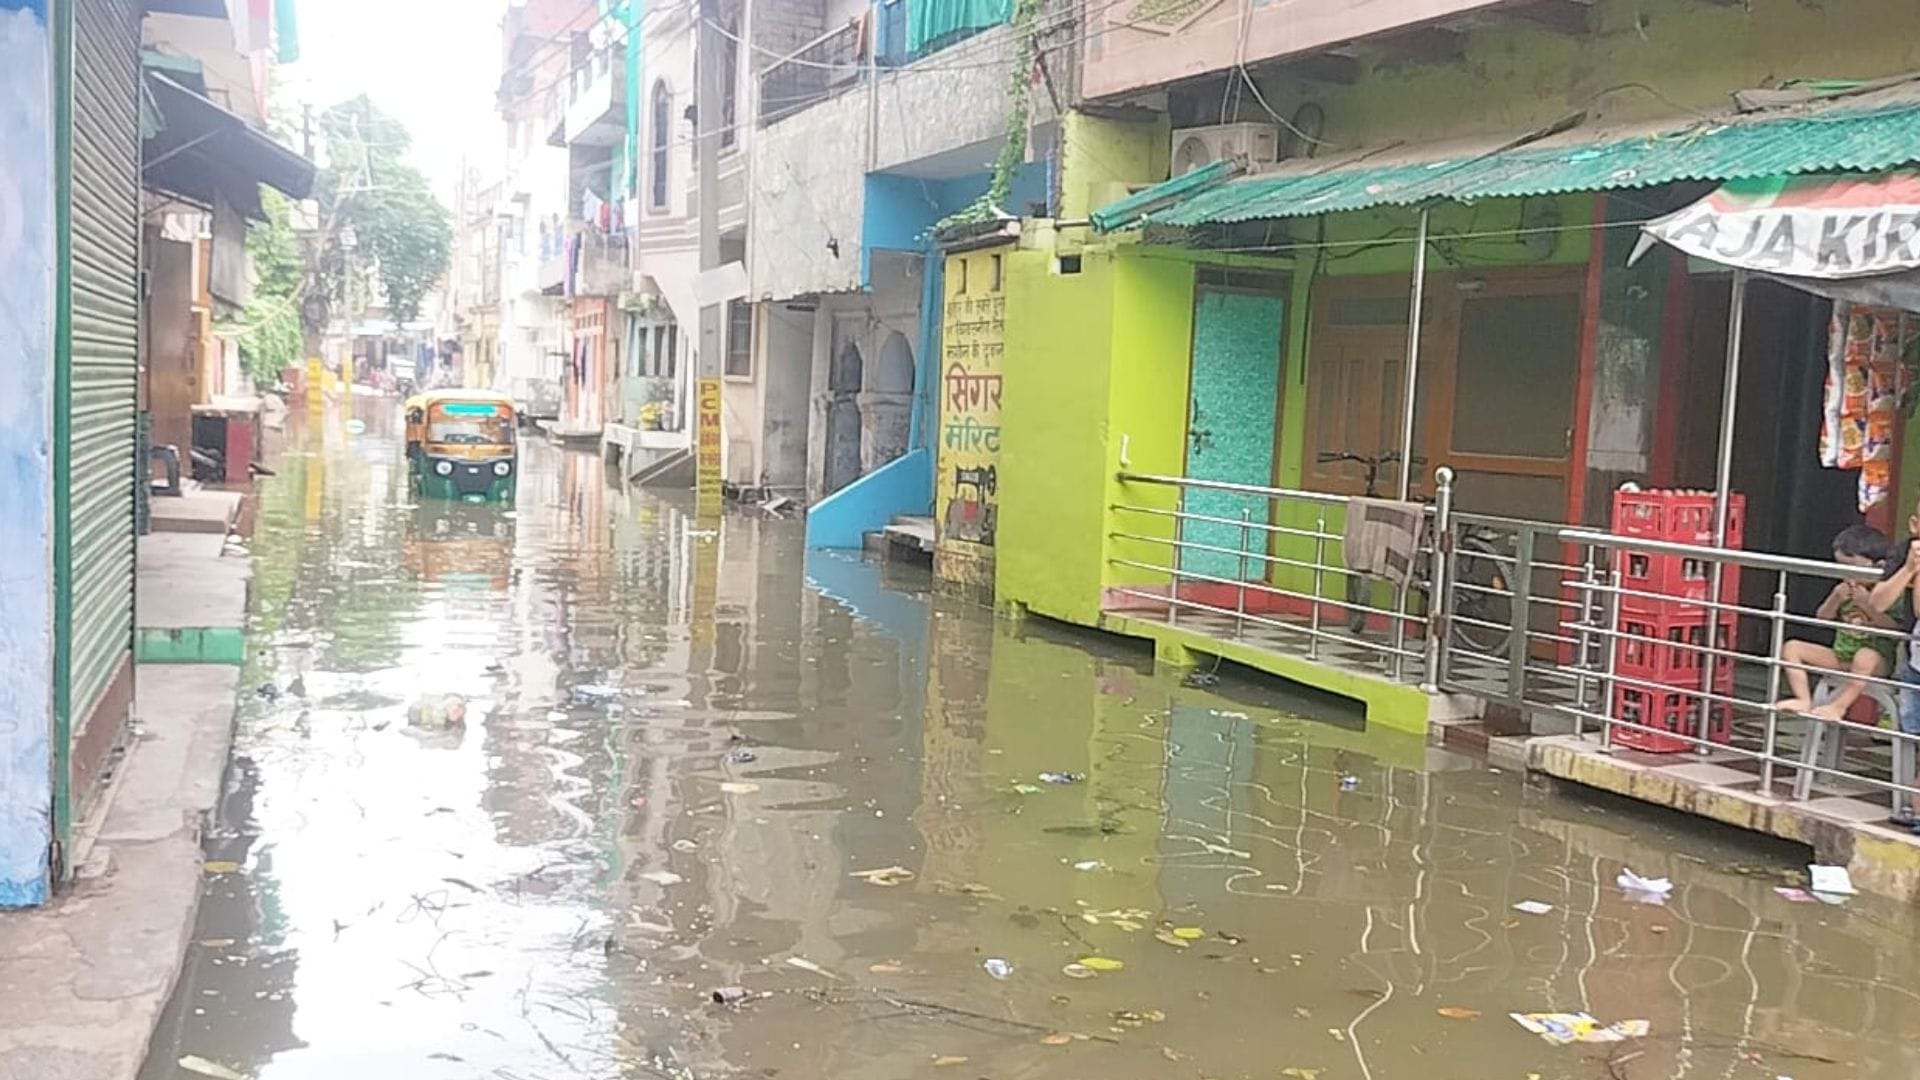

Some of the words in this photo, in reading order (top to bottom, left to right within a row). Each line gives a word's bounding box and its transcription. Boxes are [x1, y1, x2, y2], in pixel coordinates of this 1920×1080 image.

[1655, 211, 1795, 269] AJA
[945, 361, 1003, 414] सिंगर
[945, 415, 1001, 455] मेरिट
